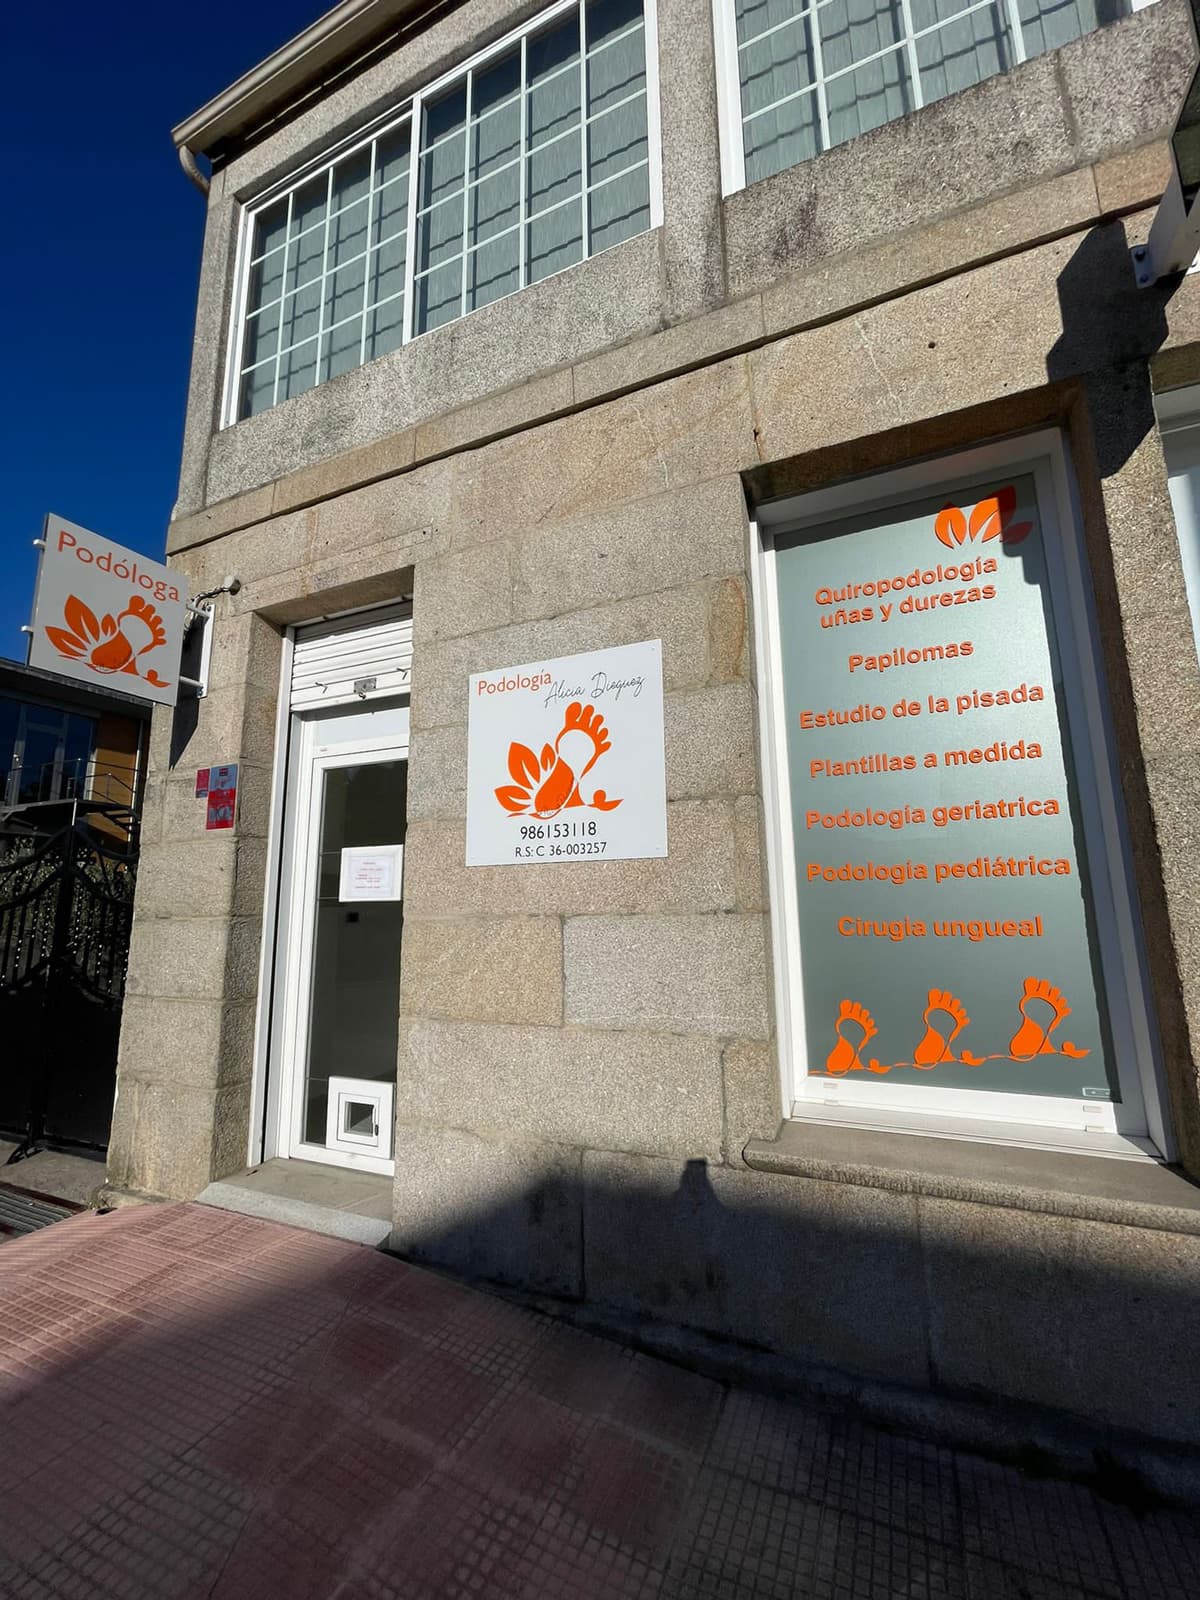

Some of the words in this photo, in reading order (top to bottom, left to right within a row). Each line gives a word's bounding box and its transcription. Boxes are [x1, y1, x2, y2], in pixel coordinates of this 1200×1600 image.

[58, 530, 179, 602] Podóloga
[815, 556, 998, 605] Quiropodología
[820, 607, 875, 629] uñas
[880, 602, 893, 622] y
[899, 584, 997, 614] durezas
[848, 640, 974, 673] Papilomas
[478, 669, 552, 696] Podología
[544, 680, 586, 708] Alicia
[800, 704, 887, 729] Estudio
[892, 699, 921, 718] de
[928, 694, 950, 714] la
[956, 682, 1045, 715] pisada
[810, 753, 917, 778] Plantillas
[923, 752, 938, 768] a
[944, 740, 1043, 766] medida
[520, 821, 597, 840] 986153118
[536, 846, 545, 857] C
[549, 842, 607, 856] 36-003257
[935, 855, 1071, 884] pediátrica
[933, 915, 1044, 942] ungueal
